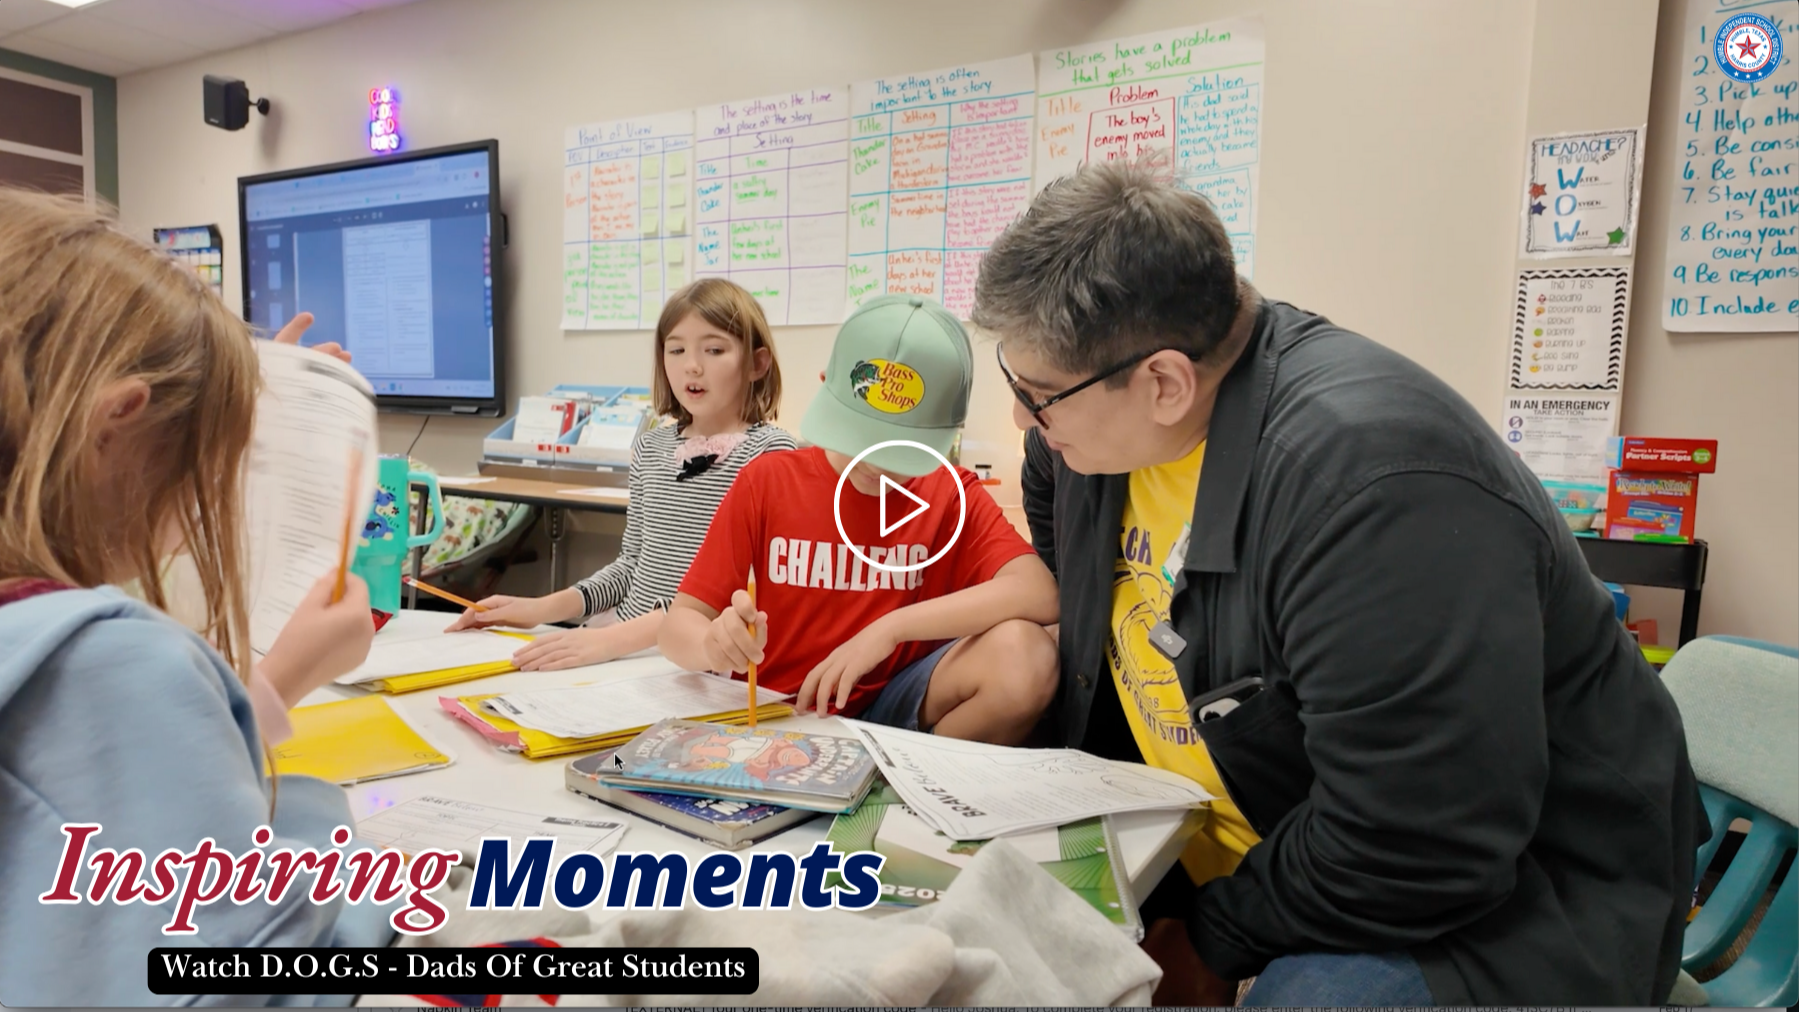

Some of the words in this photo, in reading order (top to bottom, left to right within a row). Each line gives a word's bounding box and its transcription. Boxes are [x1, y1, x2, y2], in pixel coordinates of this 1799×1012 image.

[1055, 51, 1106, 70] Stories
[1115, 43, 1146, 60] have
[1153, 42, 1163, 52] a
[1171, 28, 1231, 57] problem
[1072, 66, 1099, 85] that
[1108, 63, 1134, 86] gets
[1145, 50, 1191, 72] solved
[875, 80, 893, 96] The
[897, 76, 931, 94] setting
[936, 74, 945, 84] is
[949, 67, 980, 82] often
[1109, 86, 1159, 106] Problem
[1186, 74, 1243, 93] Solution
[870, 90, 921, 112] important
[924, 89, 937, 101] to
[942, 86, 957, 98] the
[963, 80, 992, 95] story
[1203, 93, 1221, 107] dad
[1694, 85, 1713, 106] 3.
[1719, 80, 1766, 102] Pick
[1774, 80, 1798, 100] up
[721, 105, 737, 120] The
[743, 100, 777, 116] setting
[791, 94, 804, 107] the
[811, 90, 832, 104] time
[1047, 97, 1082, 117] Title
[714, 123, 730, 136] and
[737, 120, 757, 136] place
[760, 115, 770, 127] of
[772, 114, 786, 125] the
[791, 111, 812, 126] story
[856, 117, 883, 134] Title
[902, 110, 936, 127] Setting
[1105, 115, 1128, 128] The
[1131, 107, 1161, 130] boy's
[1714, 109, 1755, 135] Help
[579, 127, 602, 146] Point
[626, 122, 652, 138] View
[753, 132, 794, 148] Setting
[1041, 123, 1075, 141] Enemy
[1094, 130, 1129, 149] enemy
[1133, 125, 1165, 142] moved
[1233, 128, 1255, 140] they
[853, 139, 886, 159] Thunder
[1049, 143, 1068, 160] Pie
[1541, 137, 1627, 157] HEADACHE?
[1715, 135, 1742, 156] Be
[700, 164, 717, 175] Title
[745, 157, 768, 168] Time
[854, 158, 880, 175] Cake
[1712, 157, 1736, 181] Be
[1749, 155, 1797, 177] fair
[1681, 187, 1697, 204] 7.
[1708, 185, 1757, 206] Stay
[851, 198, 880, 216] Enemy
[1725, 205, 1744, 221] is
[860, 213, 876, 228] Pie
[1680, 226, 1696, 241] 8.
[1702, 222, 1752, 245] Bring
[1758, 225, 1797, 244] your
[1712, 246, 1762, 263] every
[849, 264, 871, 279] The
[1696, 263, 1721, 283] Be
[848, 279, 879, 298] Name
[1696, 295, 1781, 316] Include
[882, 362, 915, 382] Bass
[880, 377, 904, 392] Pro
[878, 388, 917, 410] Shops
[1510, 400, 1521, 409] IN
[1523, 400, 1539, 410] AN
[1541, 400, 1611, 411] EMERGENCY
[1626, 452, 1659, 460] Partner
[1660, 453, 1692, 462] Scripts
